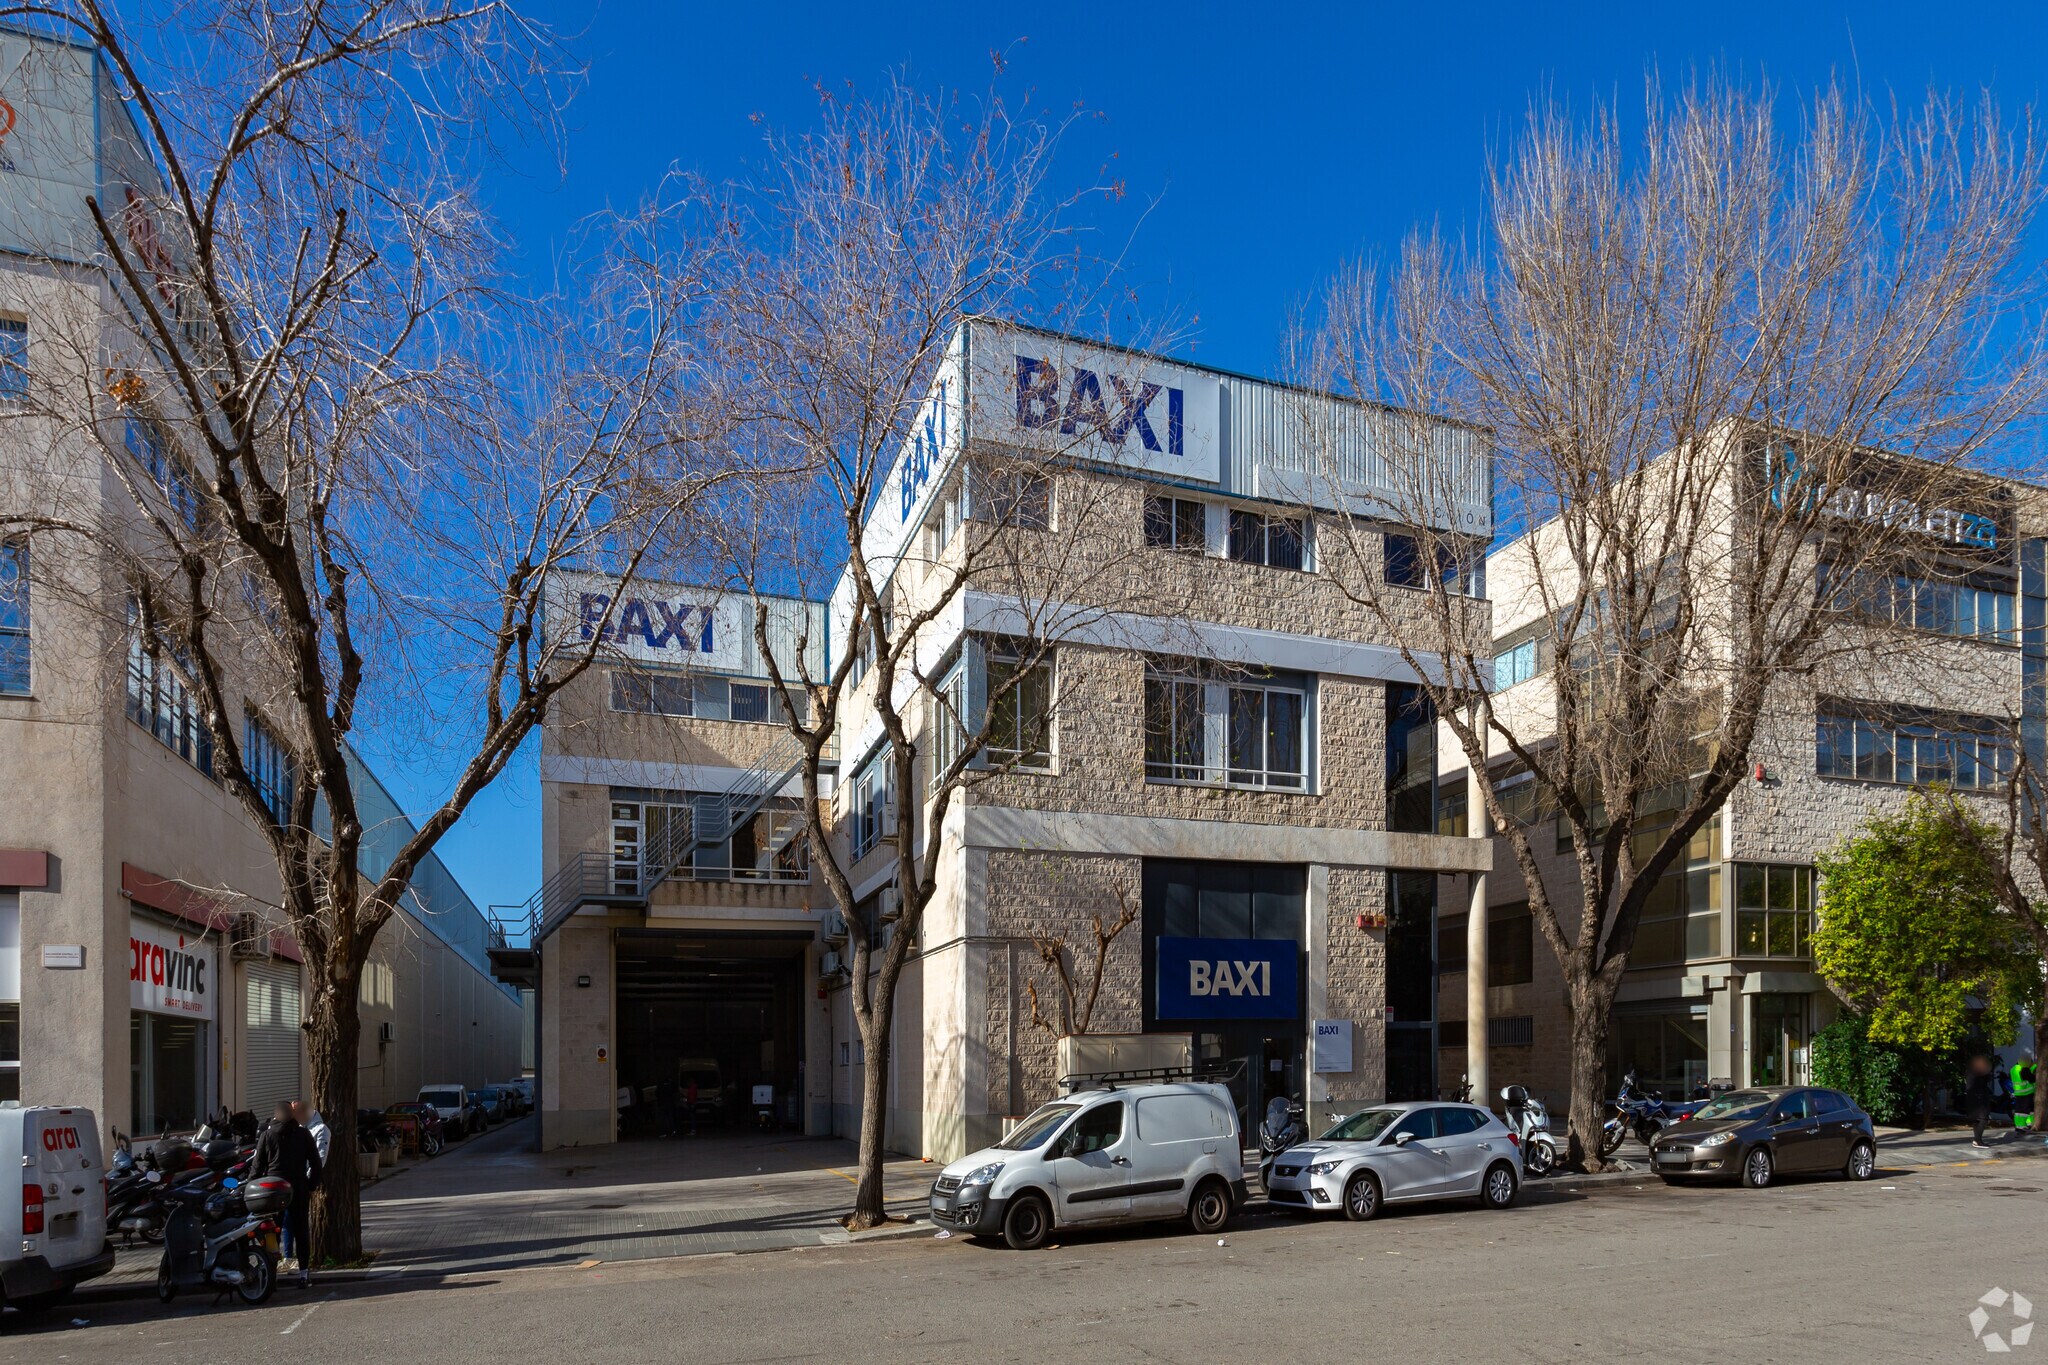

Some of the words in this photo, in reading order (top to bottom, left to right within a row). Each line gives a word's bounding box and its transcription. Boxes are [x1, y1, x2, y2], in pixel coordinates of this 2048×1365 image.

[1015, 355, 1184, 456] BAXI
[902, 378, 947, 525] BAXI
[580, 592, 713, 653] BAXI
[130, 932, 206, 995] aravinc
[1189, 960, 1271, 996] BAXI
[164, 997, 181, 1008] SMART
[182, 1000, 203, 1013] DELIVERY
[1318, 1025, 1339, 1036] BAXI
